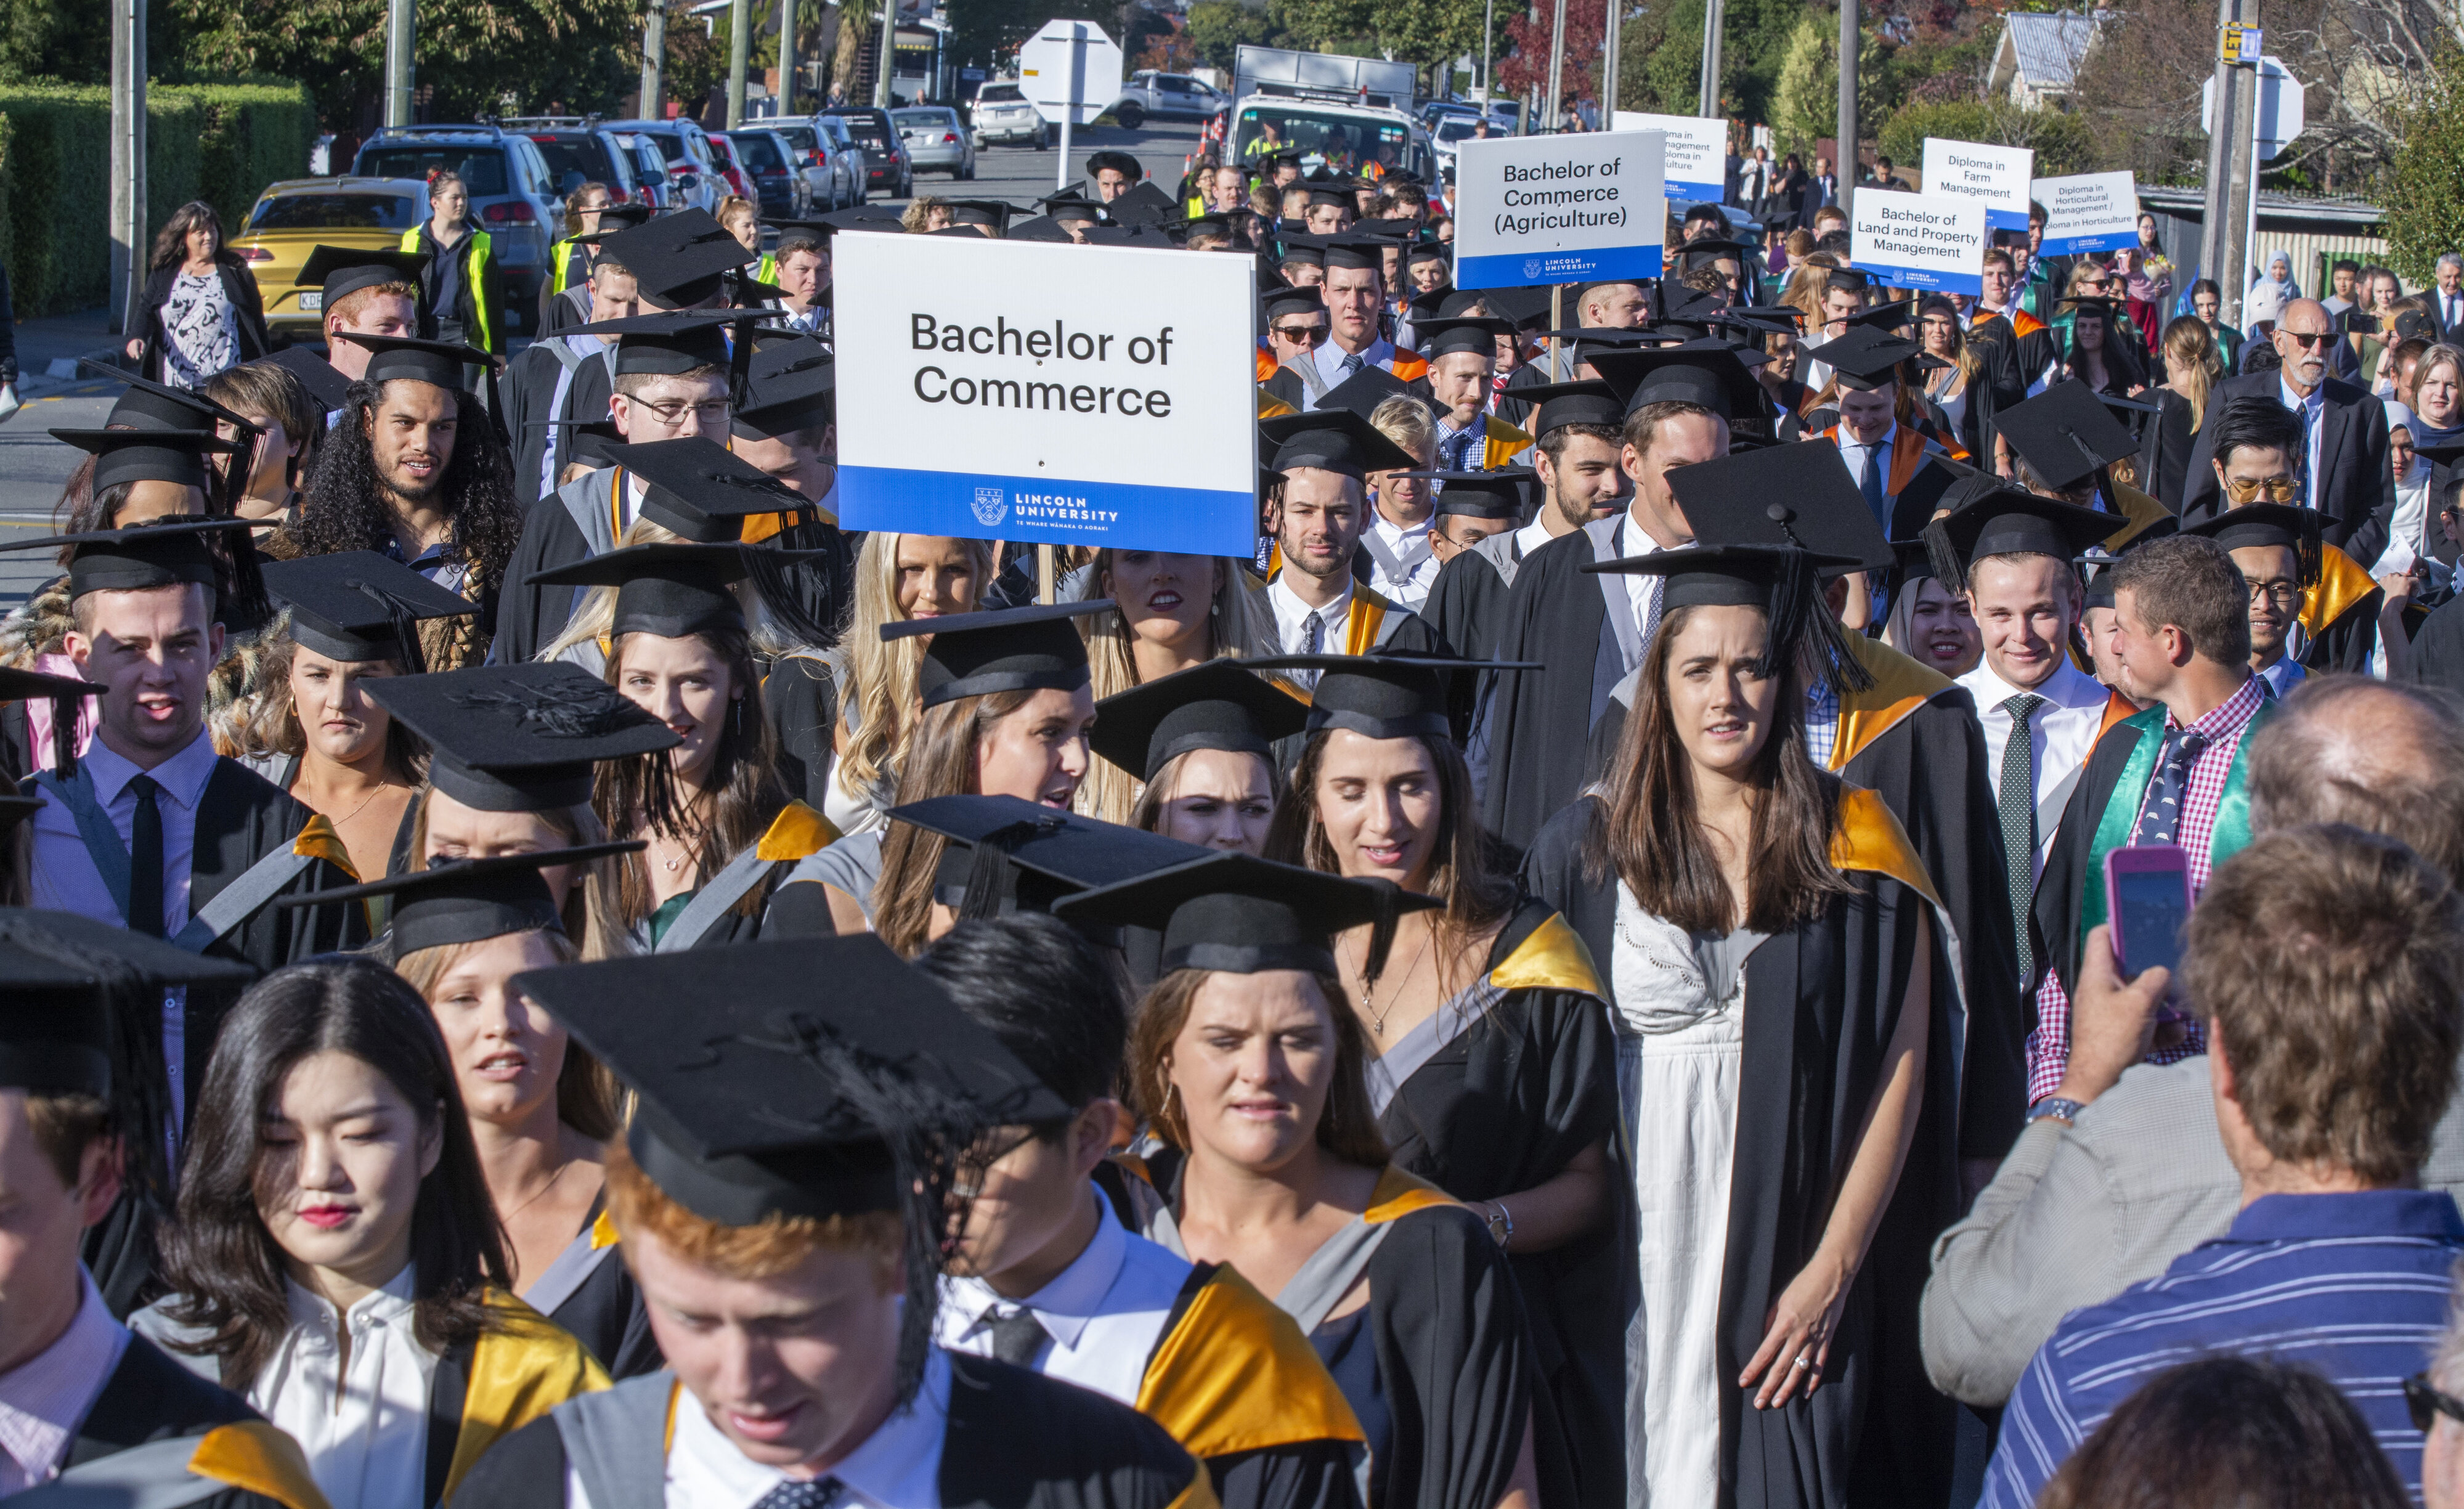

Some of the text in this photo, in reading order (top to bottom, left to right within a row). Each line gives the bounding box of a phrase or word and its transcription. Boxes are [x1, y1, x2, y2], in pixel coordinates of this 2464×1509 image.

[1684, 131, 1693, 139] in
[1665, 141, 1710, 151] nagement
[1665, 150, 1701, 160] loma in
[1503, 157, 1621, 182] Bachelor of
[1665, 160, 1693, 169] ulture
[1948, 155, 2005, 171] Diploma in
[1964, 171, 1991, 182] Farm
[1504, 187, 1619, 207] Commerce
[1940, 181, 2011, 198] Management
[2059, 184, 2104, 195] Diploma in
[2055, 193, 2108, 205] Horticultural
[2052, 202, 2113, 215] Management /
[1494, 206, 1627, 235] (Agriculture)
[1882, 208, 1957, 226] Bachelor of
[2045, 222, 2071, 230] ploma
[2082, 216, 2132, 226] Horticulture
[1858, 221, 1978, 246] Land and Property
[1874, 238, 1961, 258] Management
[1545, 263, 1596, 271] UNIVERSITY
[911, 312, 1173, 365] Bachelor of
[914, 365, 1171, 418] Commerce
[1016, 494, 1086, 508] LINCOLN
[1016, 506, 1118, 522] UNIVERSITY
